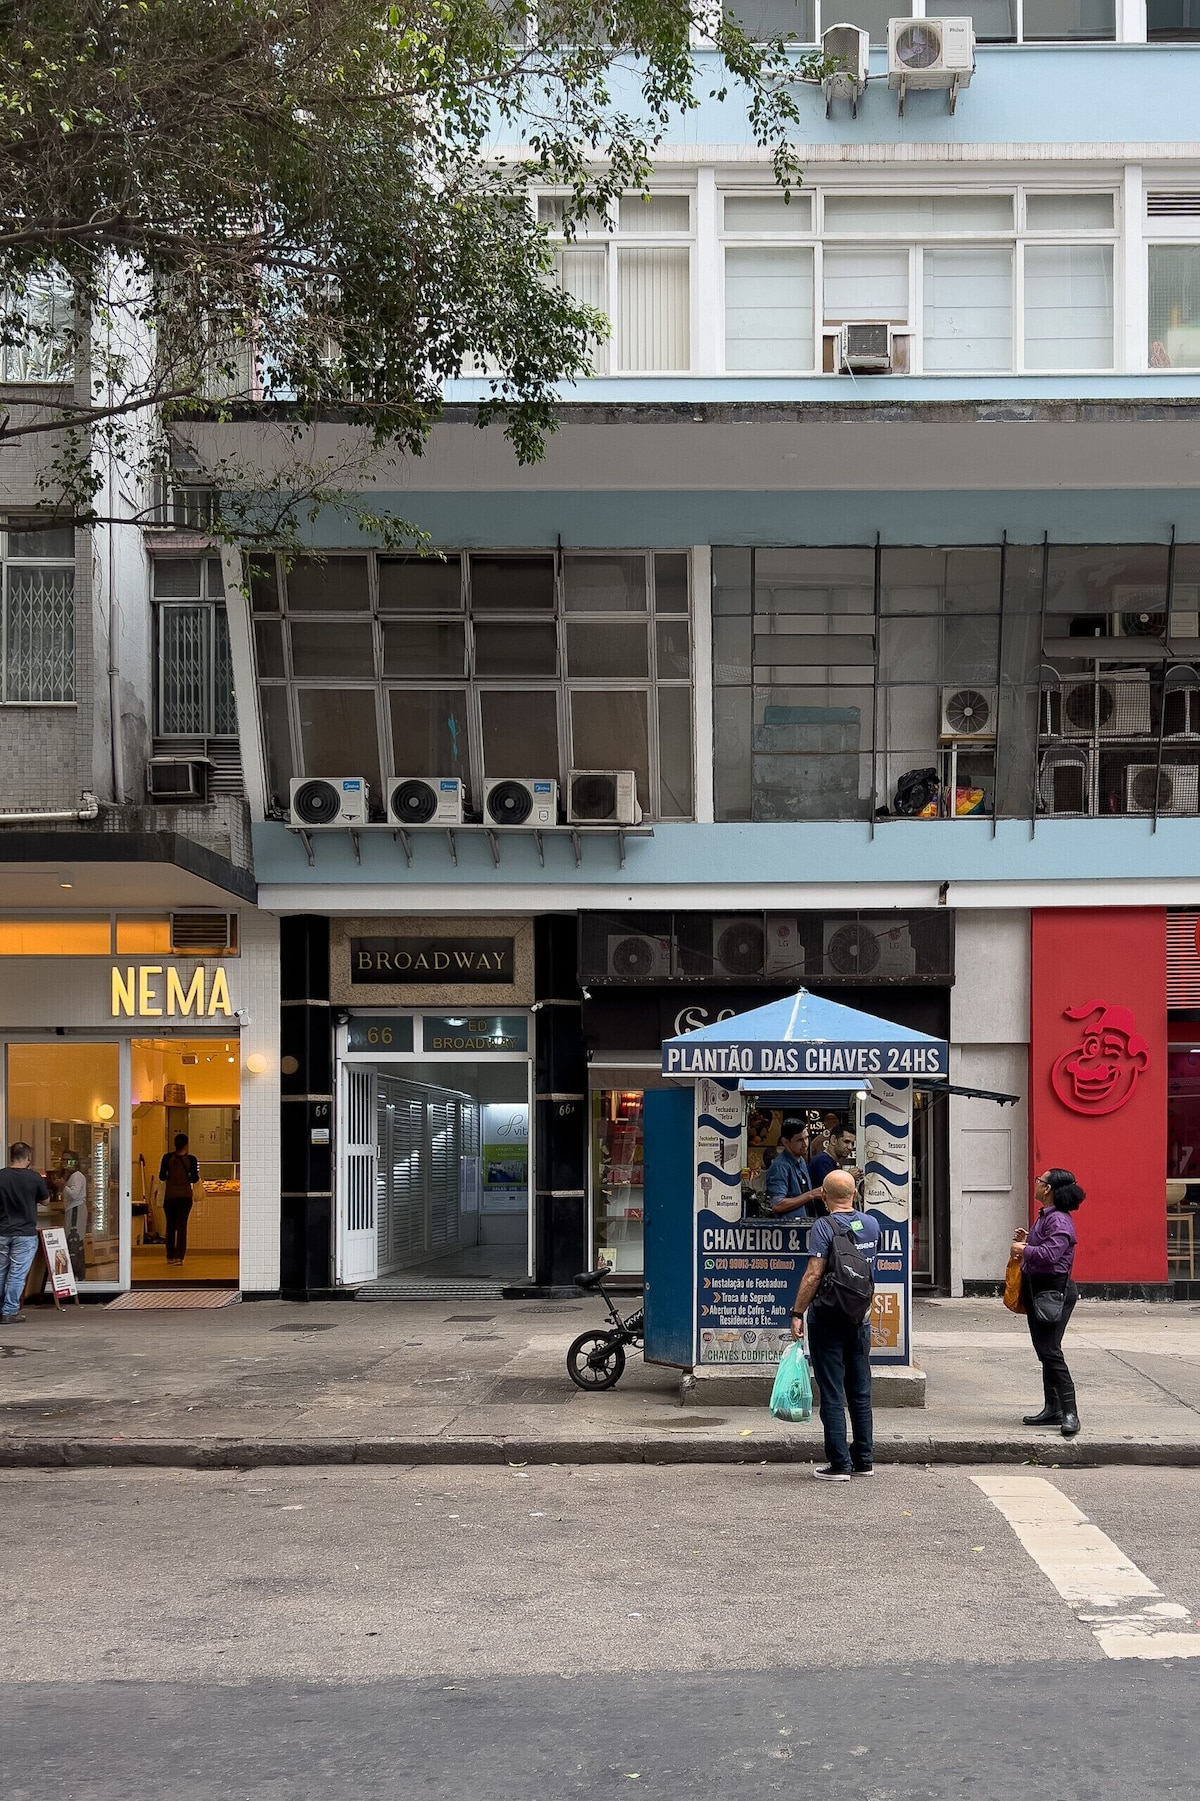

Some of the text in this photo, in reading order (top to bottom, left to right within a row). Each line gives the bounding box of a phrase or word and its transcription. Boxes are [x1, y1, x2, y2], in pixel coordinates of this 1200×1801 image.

[778, 939, 790, 948] LG
[358, 951, 506, 970] BROADWAY
[112, 966, 232, 1016] NEMA
[468, 1020, 488, 1032] ED
[367, 1026, 393, 1045] 66
[433, 1037, 517, 1049] BROADWAY
[668, 1045, 940, 1072] PLANTÃO DAS CHAVES 24HS
[315, 1104, 328, 1117] 66
[703, 1228, 783, 1251] CHAVEIRO
[788, 1229, 800, 1251] &
[711, 1277, 788, 1290] Instalação de Fechadura
[721, 1292, 775, 1305] Troca de Segredo
[709, 1304, 737, 1316] Abertura
[738, 1304, 747, 1316] de
[747, 1304, 765, 1316] Cofre
[771, 1305, 786, 1316] Auto
[720, 1315, 754, 1326] Residência
[707, 1349, 739, 1361] CHAVES
